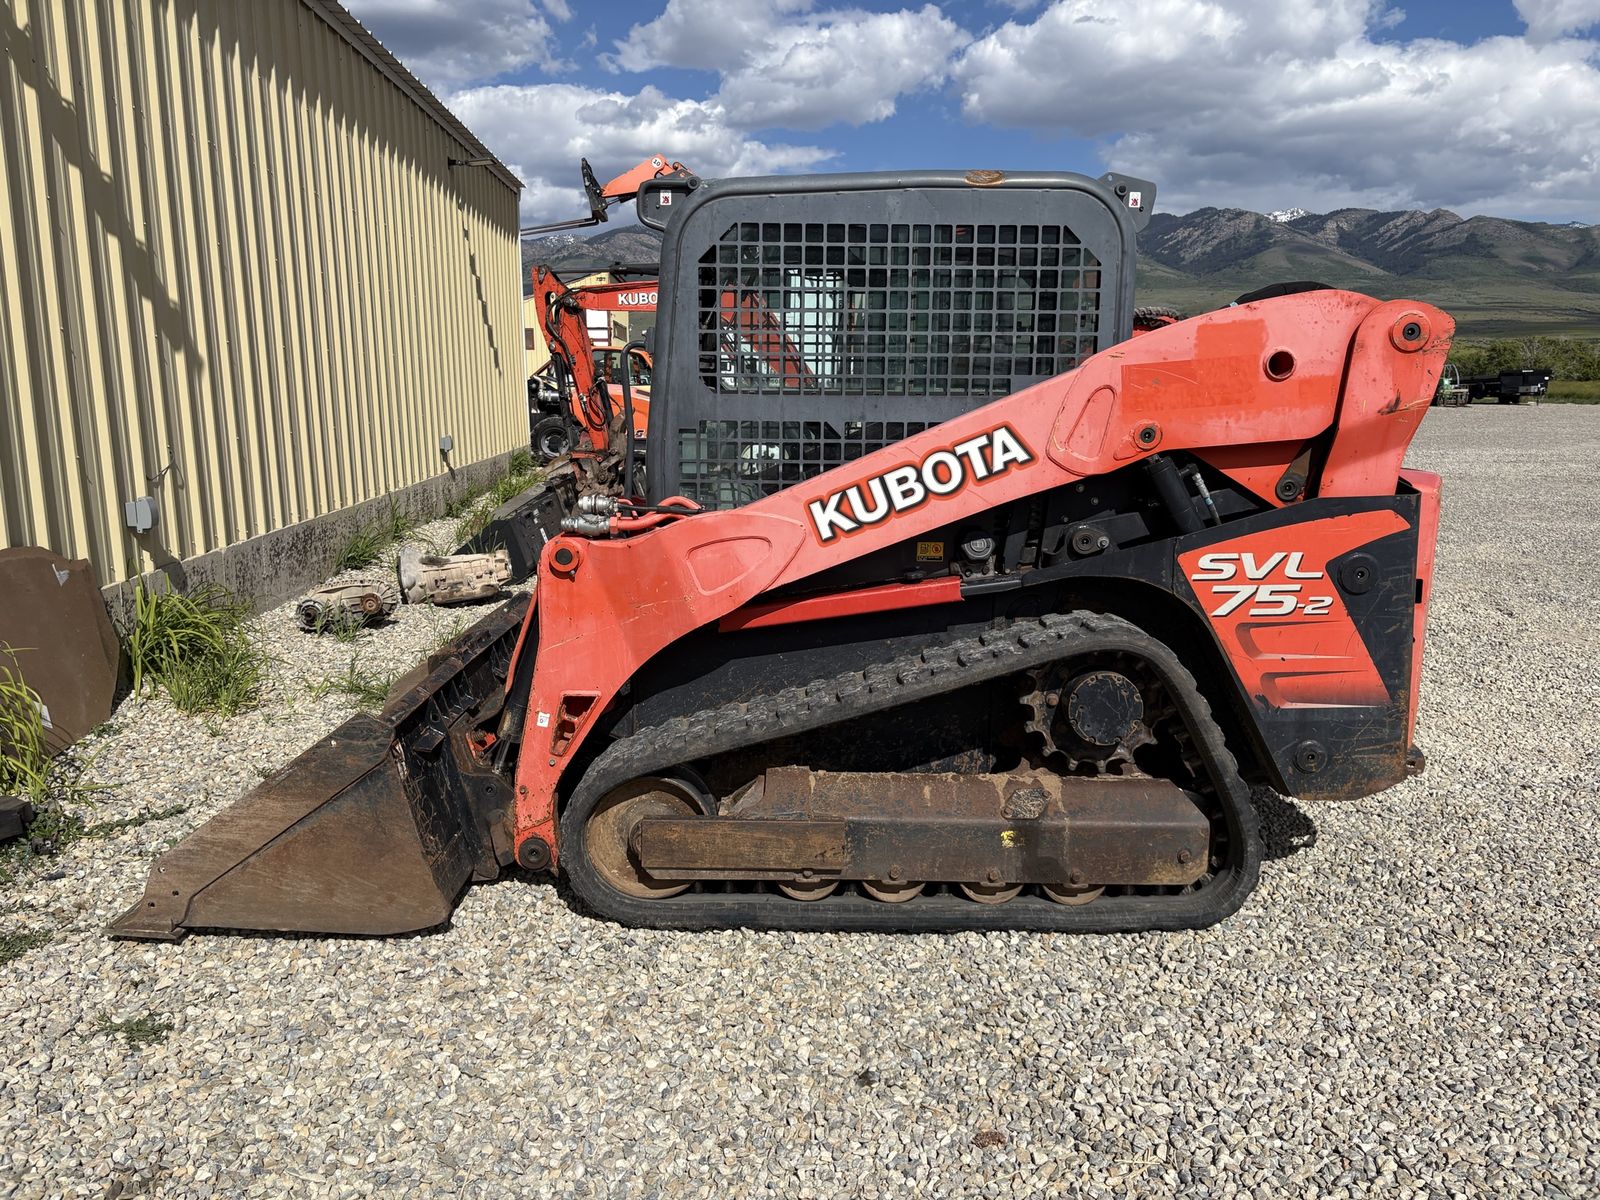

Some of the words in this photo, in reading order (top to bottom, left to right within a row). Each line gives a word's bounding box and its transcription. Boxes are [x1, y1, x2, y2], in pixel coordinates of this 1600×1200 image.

[618, 292, 658, 305] KUBO
[809, 426, 1031, 541] KUBOTA
[1191, 552, 1324, 581] SVL
[1211, 584, 1333, 617] 75-2
